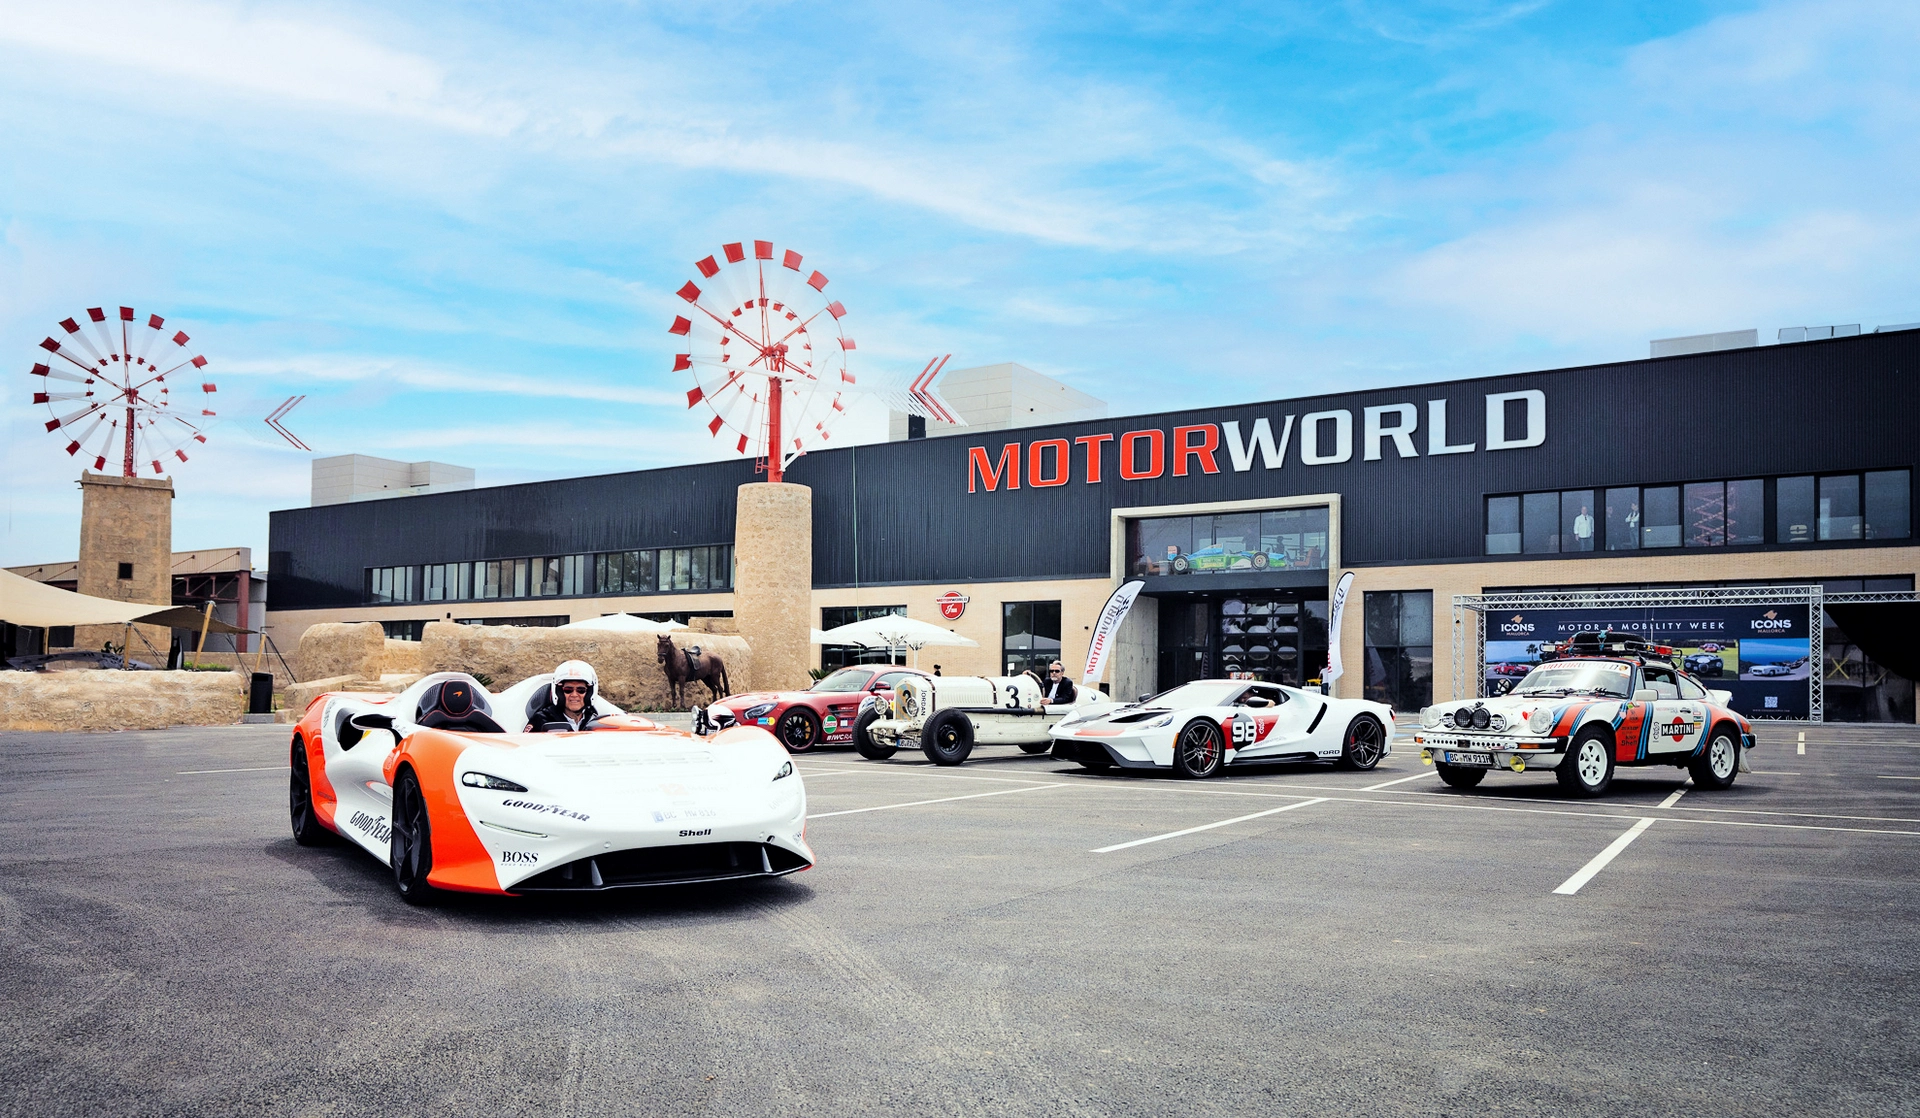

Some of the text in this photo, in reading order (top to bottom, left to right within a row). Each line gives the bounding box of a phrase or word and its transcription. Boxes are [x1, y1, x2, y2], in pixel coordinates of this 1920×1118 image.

[968, 389, 1546, 493] MOTORWORLD
[1501, 623, 1535, 632] ICONS
[1690, 621, 1725, 630] WEEK
[1751, 619, 1792, 629] ICONS
[1086, 594, 1125, 674] MOTORWORLD
[1005, 684, 1020, 708] 3
[920, 689, 928, 716] JORDAN
[1232, 721, 1255, 743] 98
[1662, 724, 1694, 735] MARTINI
[826, 733, 853, 741] #IWCRA
[502, 799, 590, 822] GOODYEAR
[678, 828, 712, 837] Shell
[502, 851, 539, 863] BOSS
